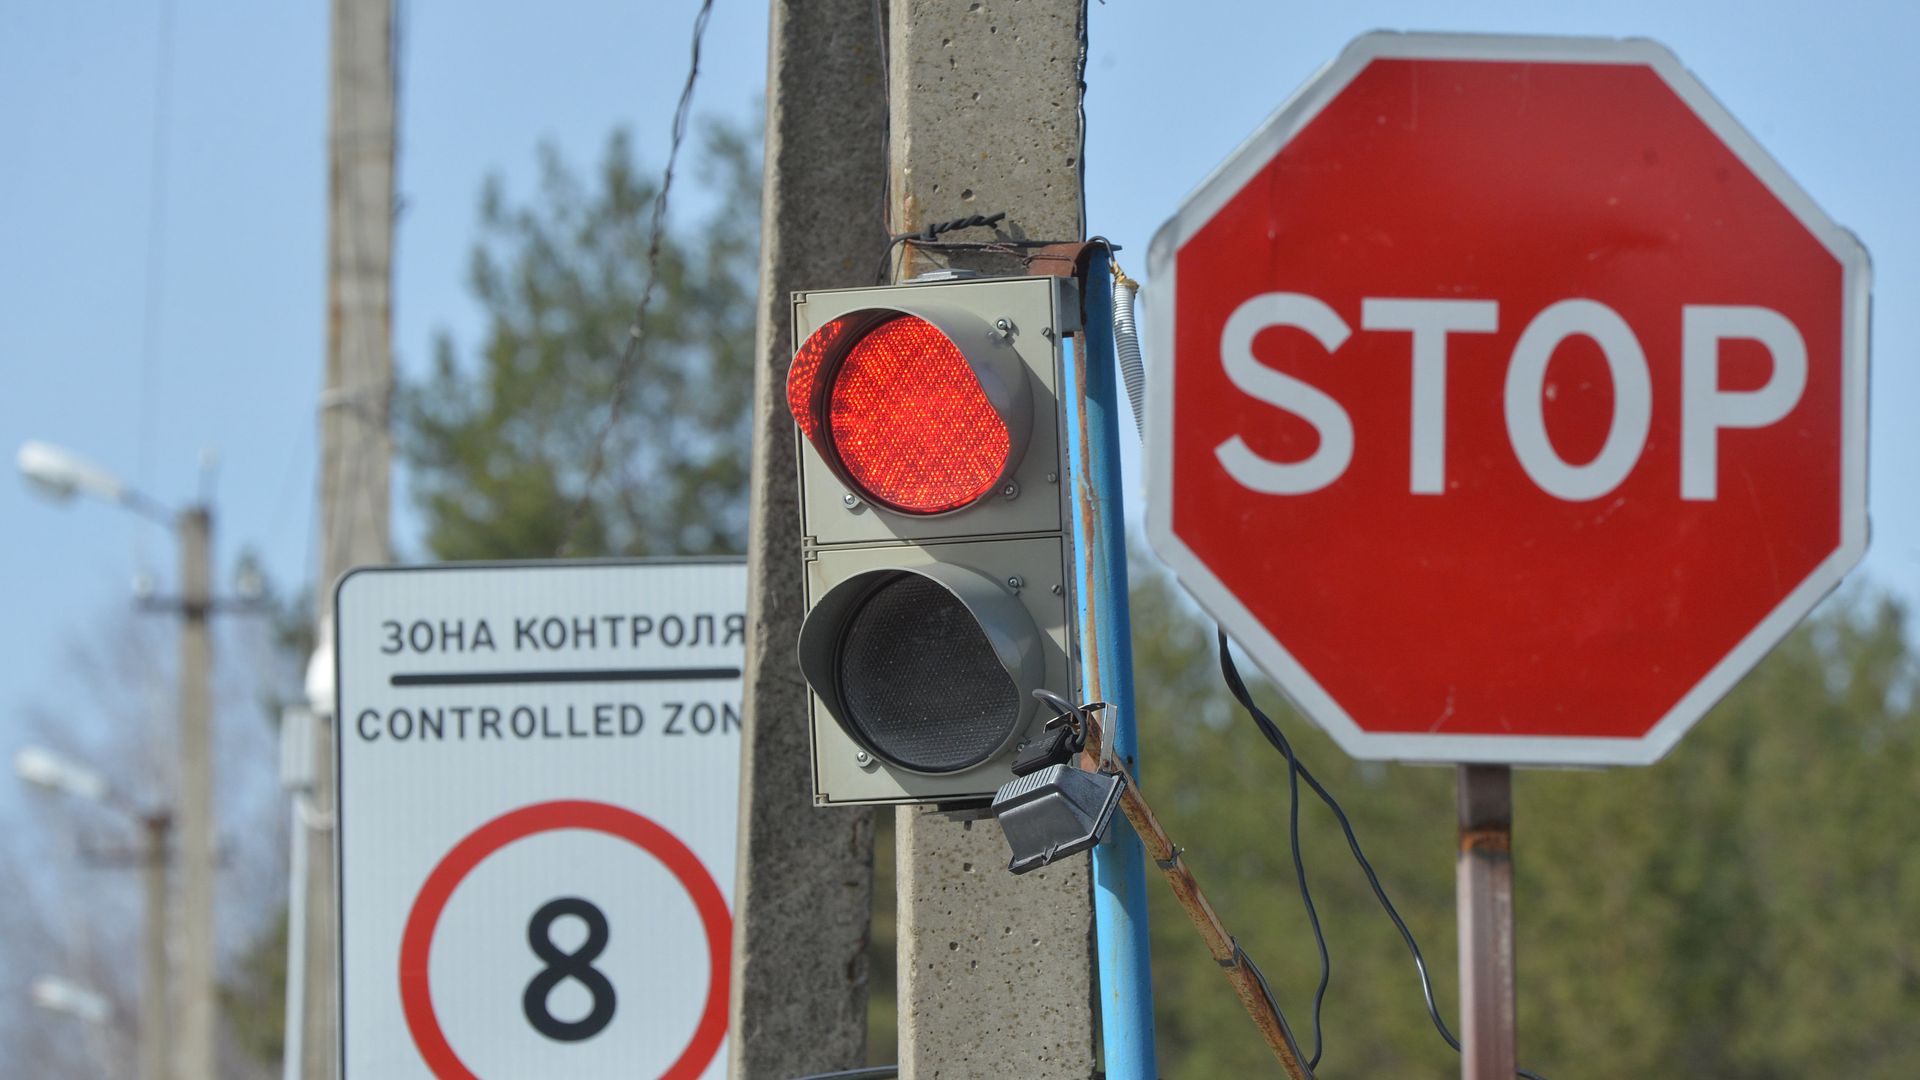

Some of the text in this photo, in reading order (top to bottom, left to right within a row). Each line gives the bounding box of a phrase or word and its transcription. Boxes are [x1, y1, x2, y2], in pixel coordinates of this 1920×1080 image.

[1214, 291, 1809, 501] STOP
[380, 614, 745, 654] ЗОНА КОНТРОЛЯ
[356, 703, 645, 742] CONTROLLED
[522, 897, 616, 1043] 8
